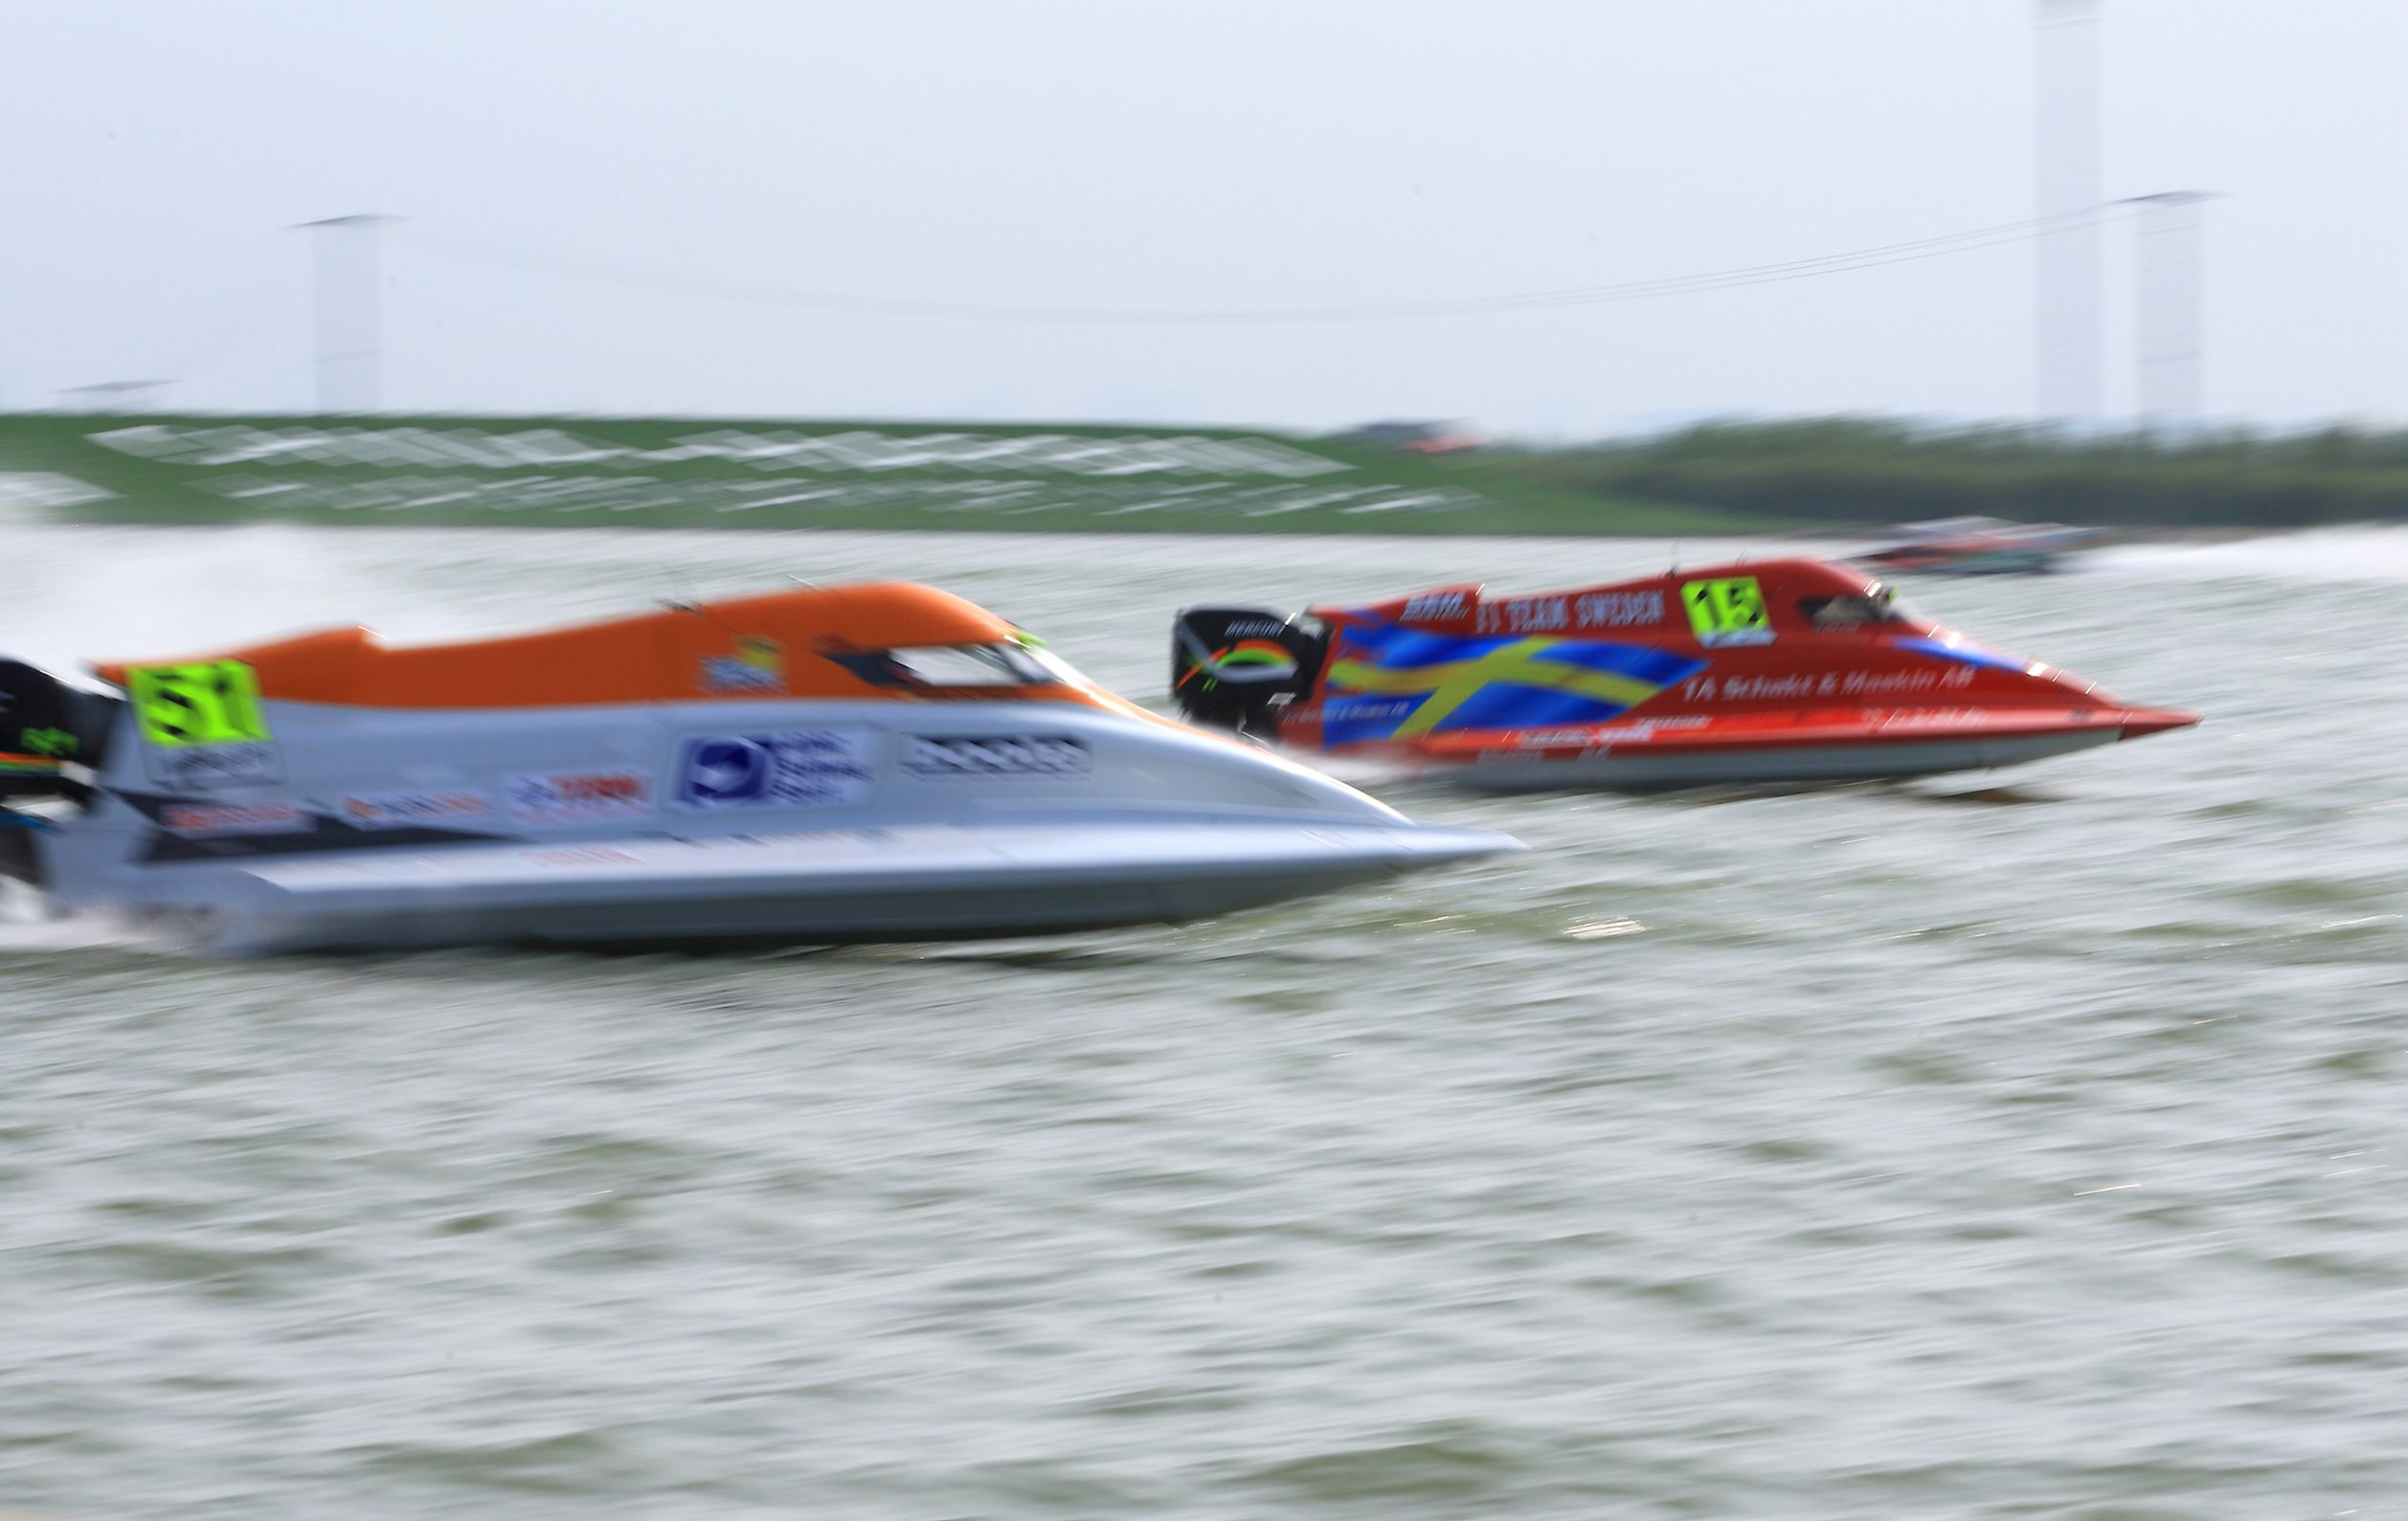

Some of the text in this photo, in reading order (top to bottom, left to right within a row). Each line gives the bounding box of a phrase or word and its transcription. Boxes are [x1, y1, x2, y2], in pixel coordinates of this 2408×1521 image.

[1575, 590, 1665, 628] SWEDEN
[1694, 579, 1764, 628] 15
[142, 664, 253, 743] 51
